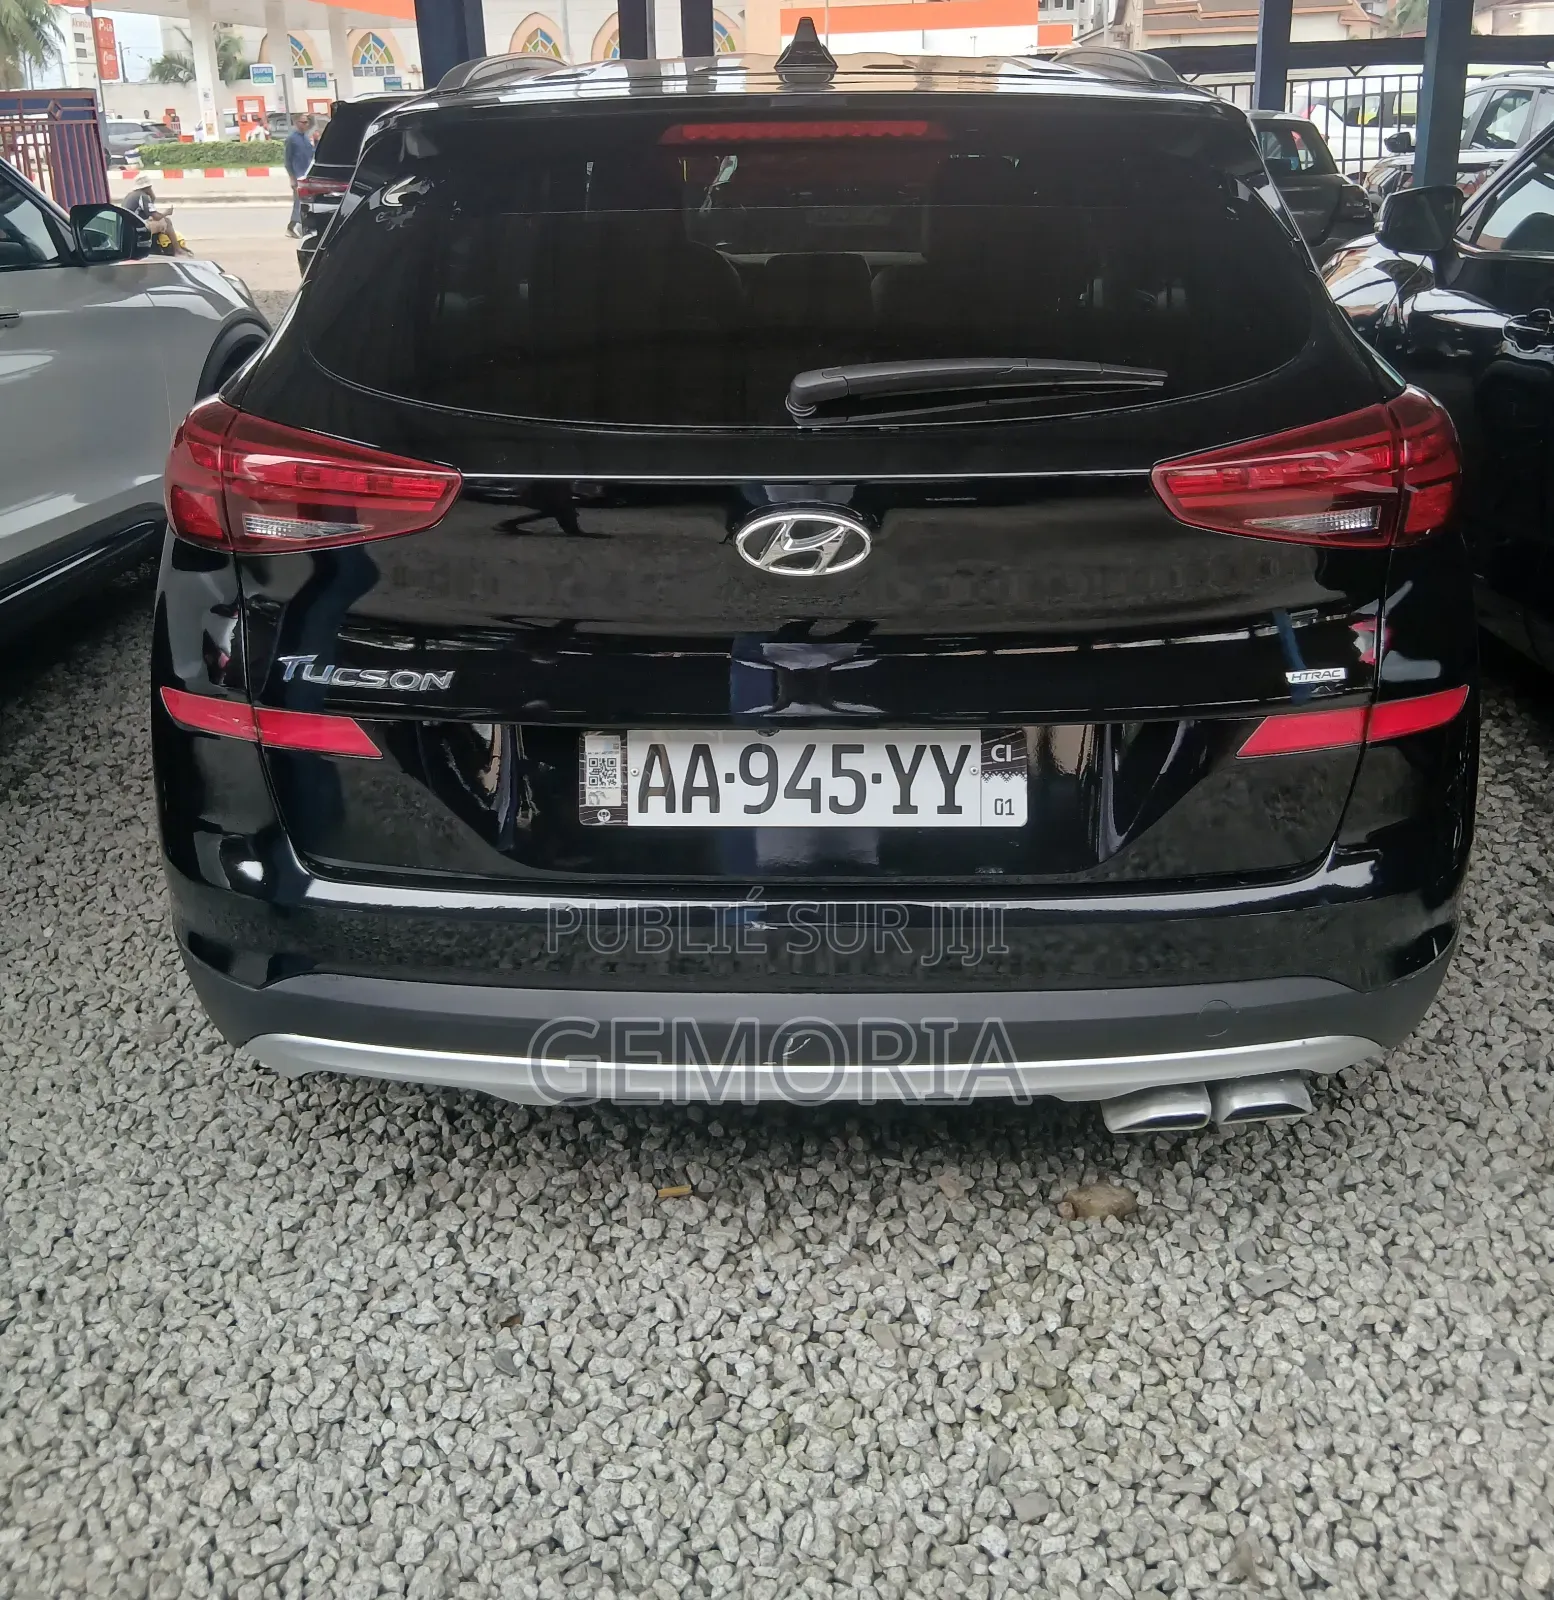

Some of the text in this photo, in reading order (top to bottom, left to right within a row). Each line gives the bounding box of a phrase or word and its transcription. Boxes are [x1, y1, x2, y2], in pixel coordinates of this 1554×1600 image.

[278, 654, 456, 691] TUCSON
[1292, 670, 1341, 681] HTRAC
[991, 744, 1012, 762] CI
[994, 798, 1015, 815] 01
